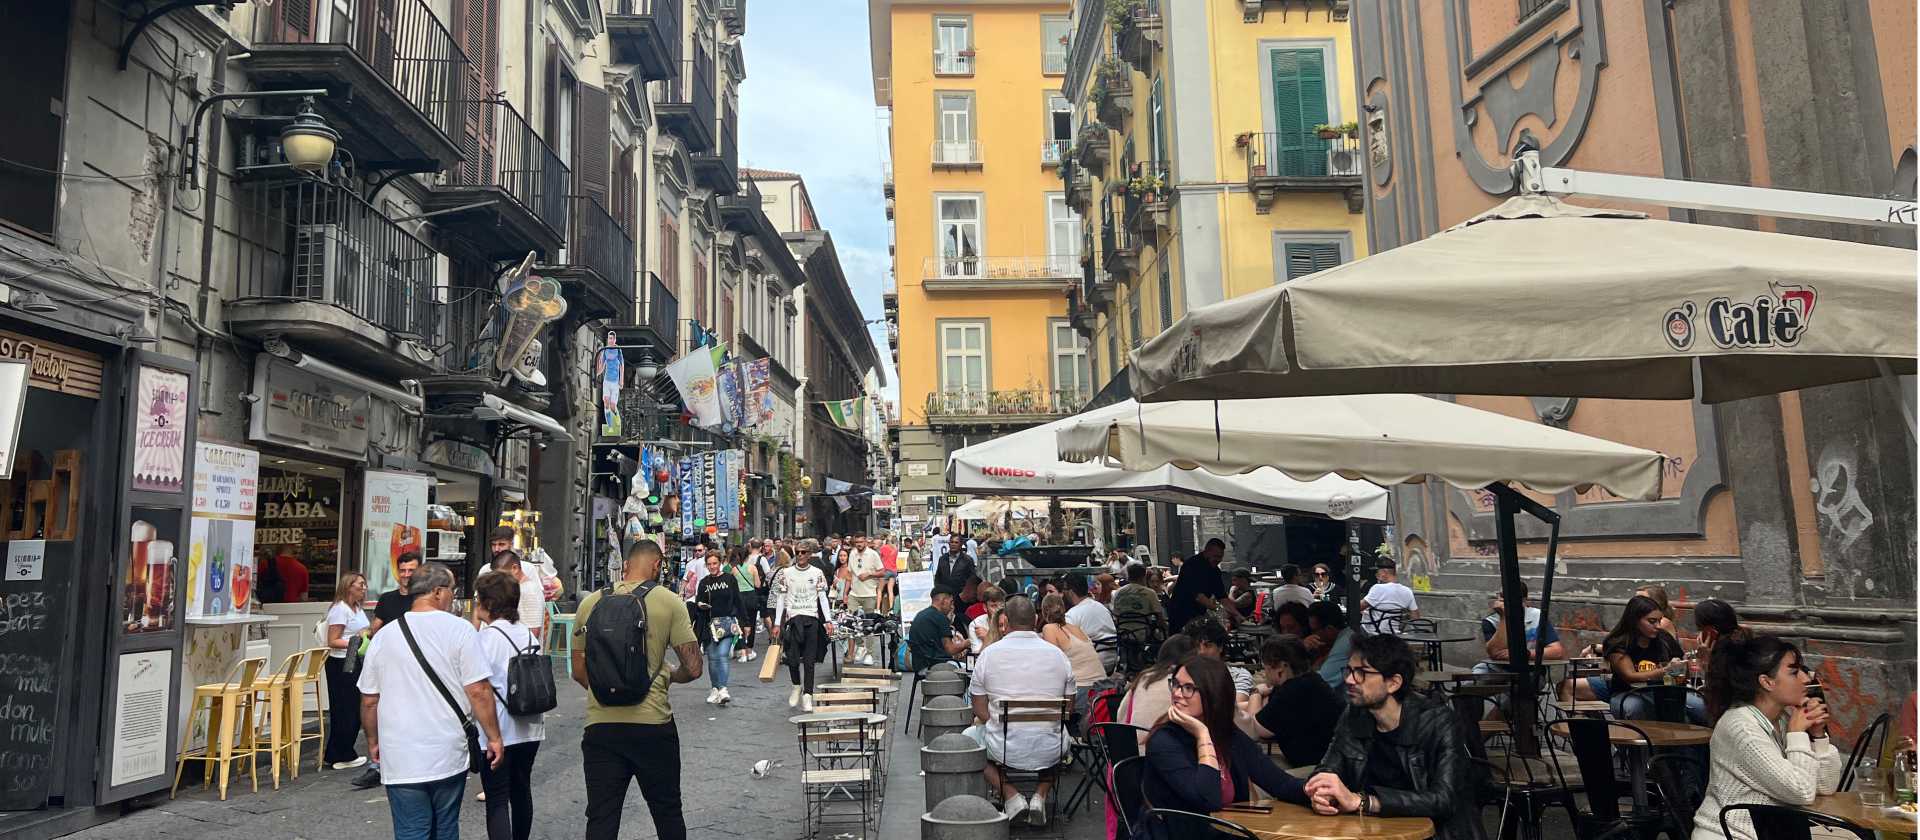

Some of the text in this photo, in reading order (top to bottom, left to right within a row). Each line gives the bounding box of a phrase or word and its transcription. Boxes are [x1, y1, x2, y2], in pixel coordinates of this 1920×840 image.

[981, 466, 1036, 478] KIMBO
[371, 496, 391, 504] APEROL
[371, 505, 391, 513] SPRITZ
